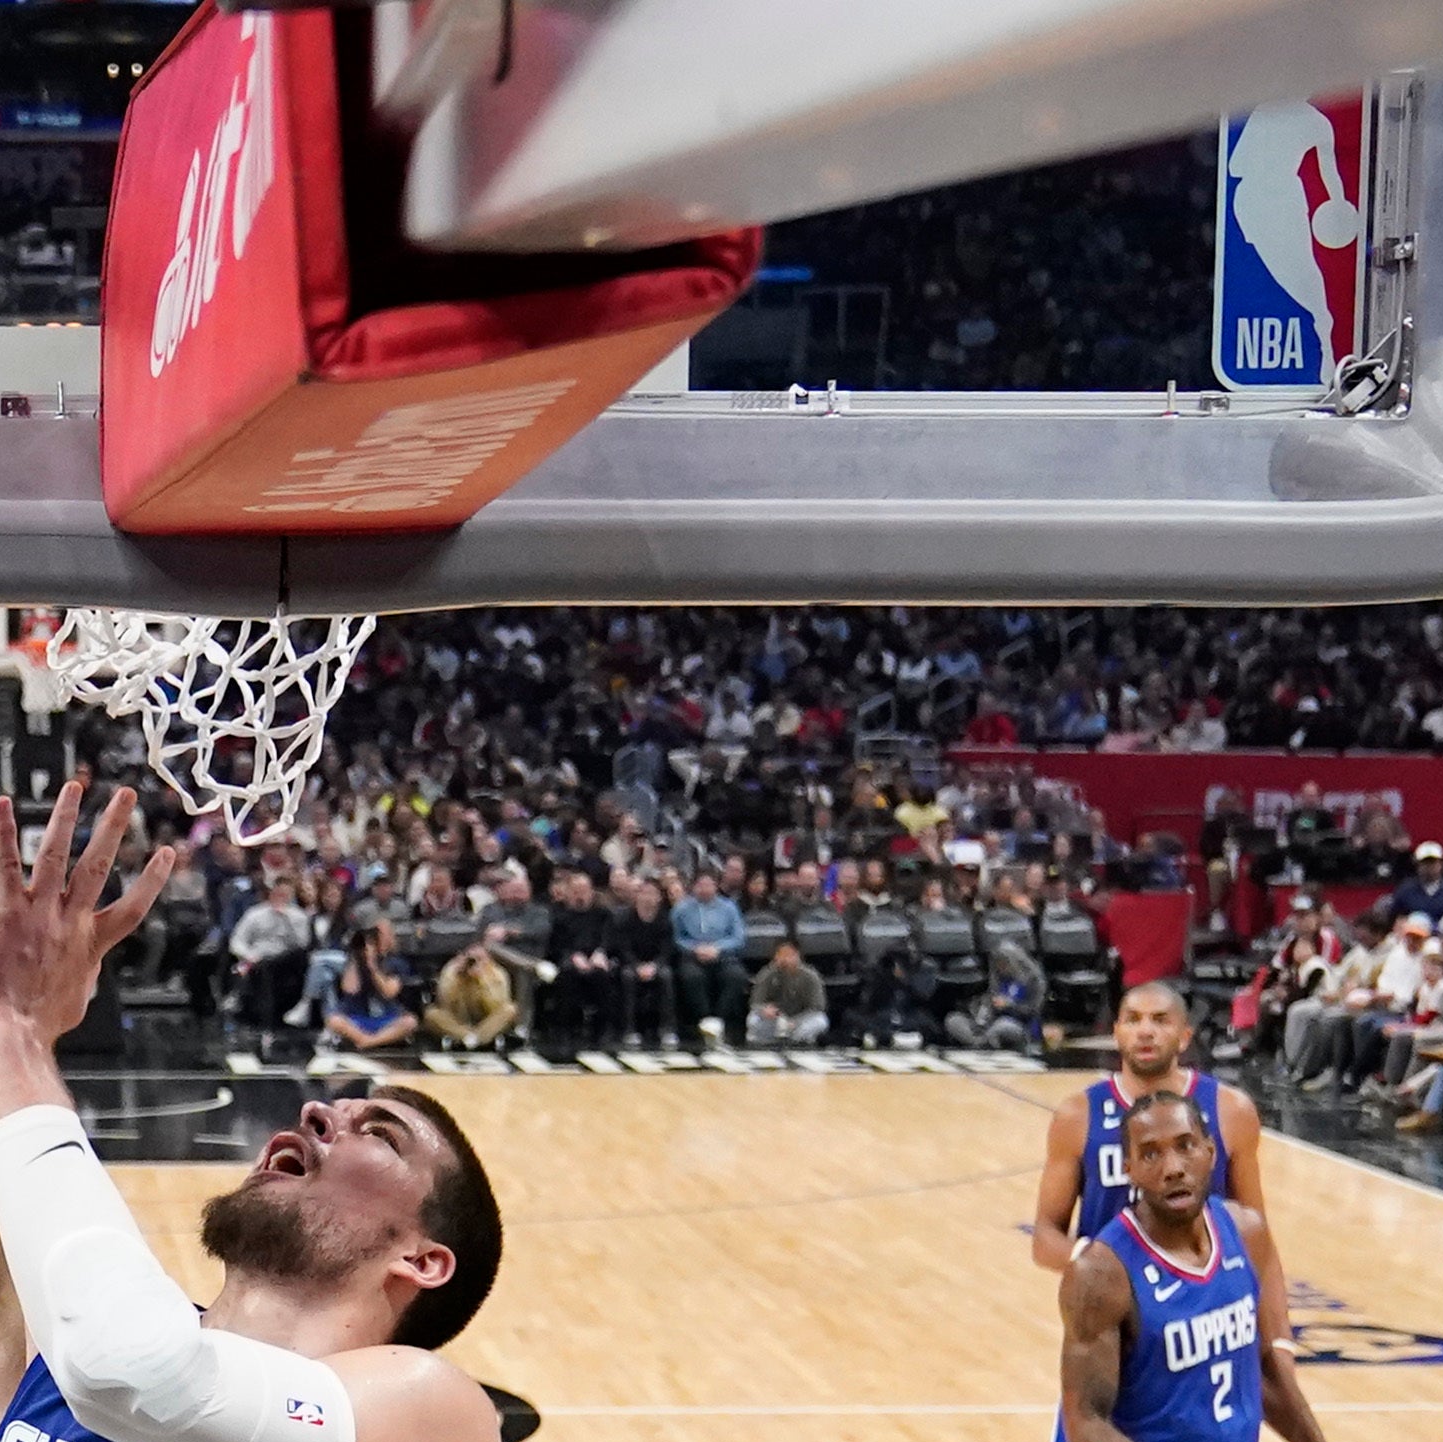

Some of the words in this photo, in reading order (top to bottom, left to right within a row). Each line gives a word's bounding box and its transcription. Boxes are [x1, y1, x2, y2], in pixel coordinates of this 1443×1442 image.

[1235, 317, 1304, 370] NBA
[1163, 1295, 1257, 1373] CLIPPERS
[1210, 1360, 1233, 1424] 2
